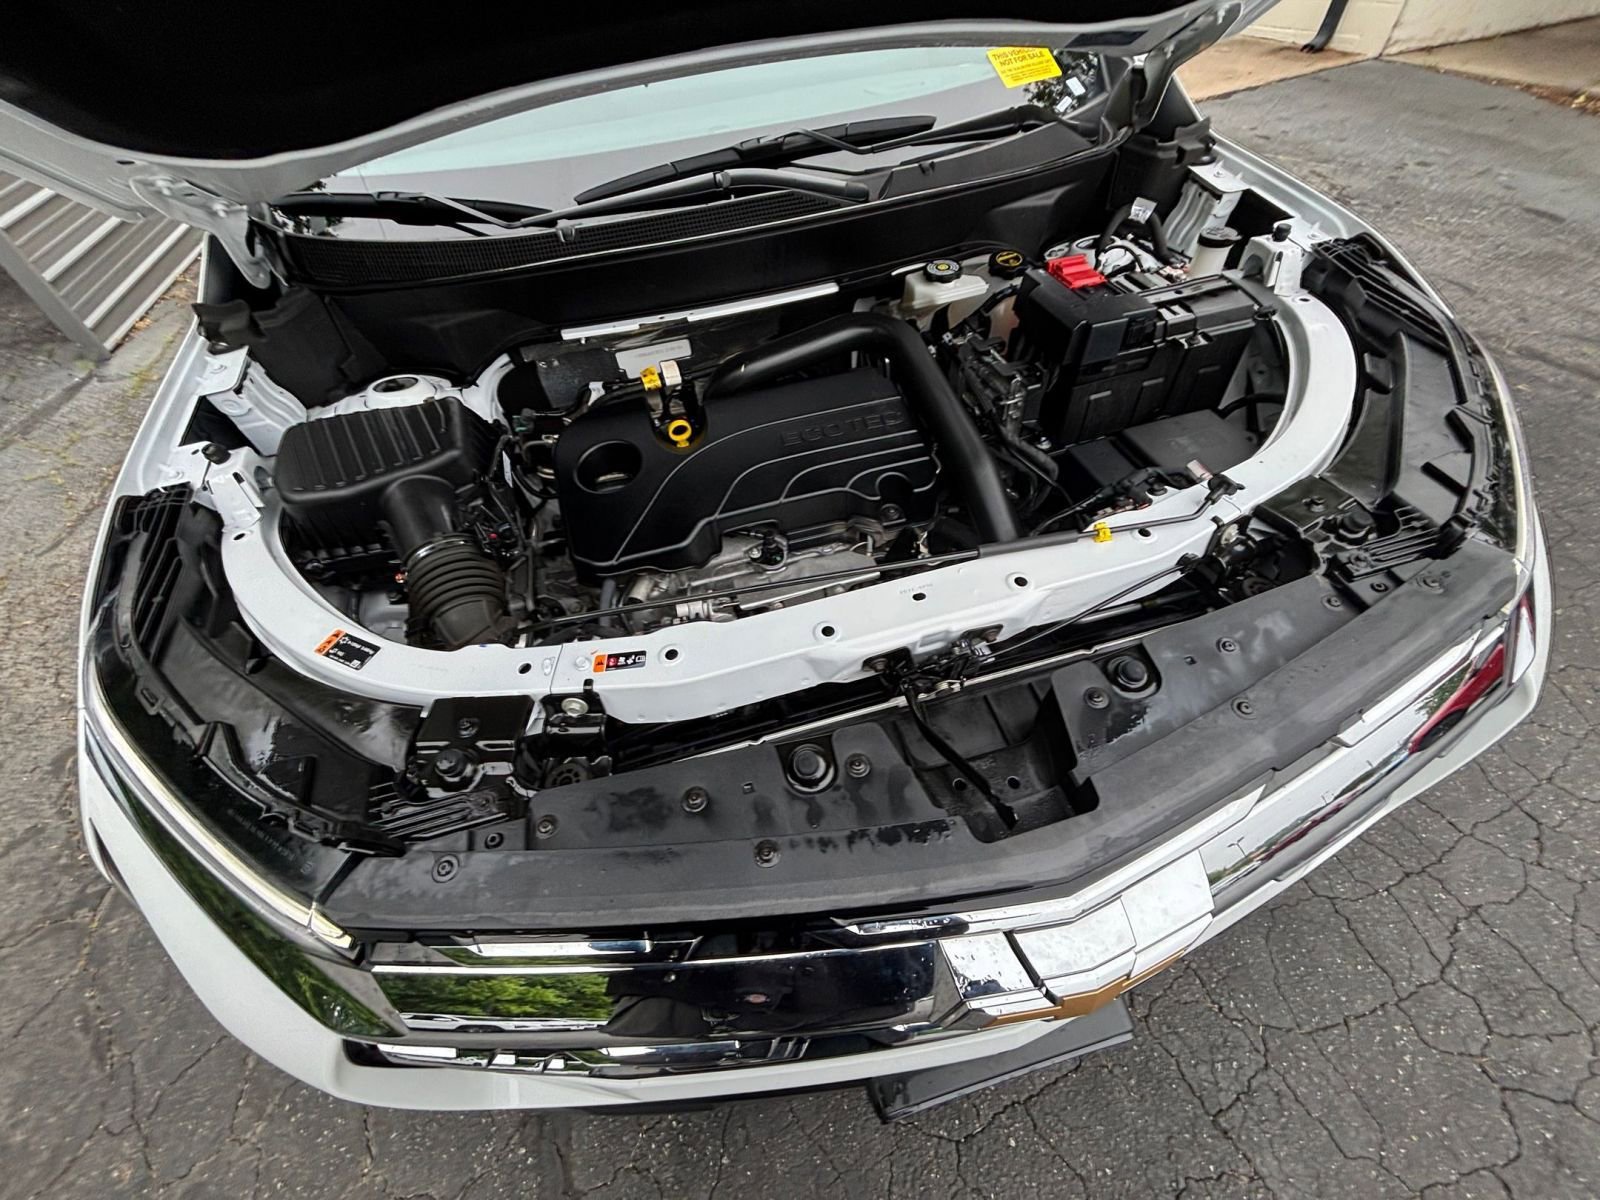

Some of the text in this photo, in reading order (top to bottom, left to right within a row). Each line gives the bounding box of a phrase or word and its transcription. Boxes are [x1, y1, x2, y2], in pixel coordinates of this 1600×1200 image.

[992, 52, 1008, 61] THIS
[999, 58, 1013, 67] NOT
[1013, 54, 1027, 63] FOR
[1027, 51, 1045, 60] SALE
[781, 411, 903, 446] ECOTEC
